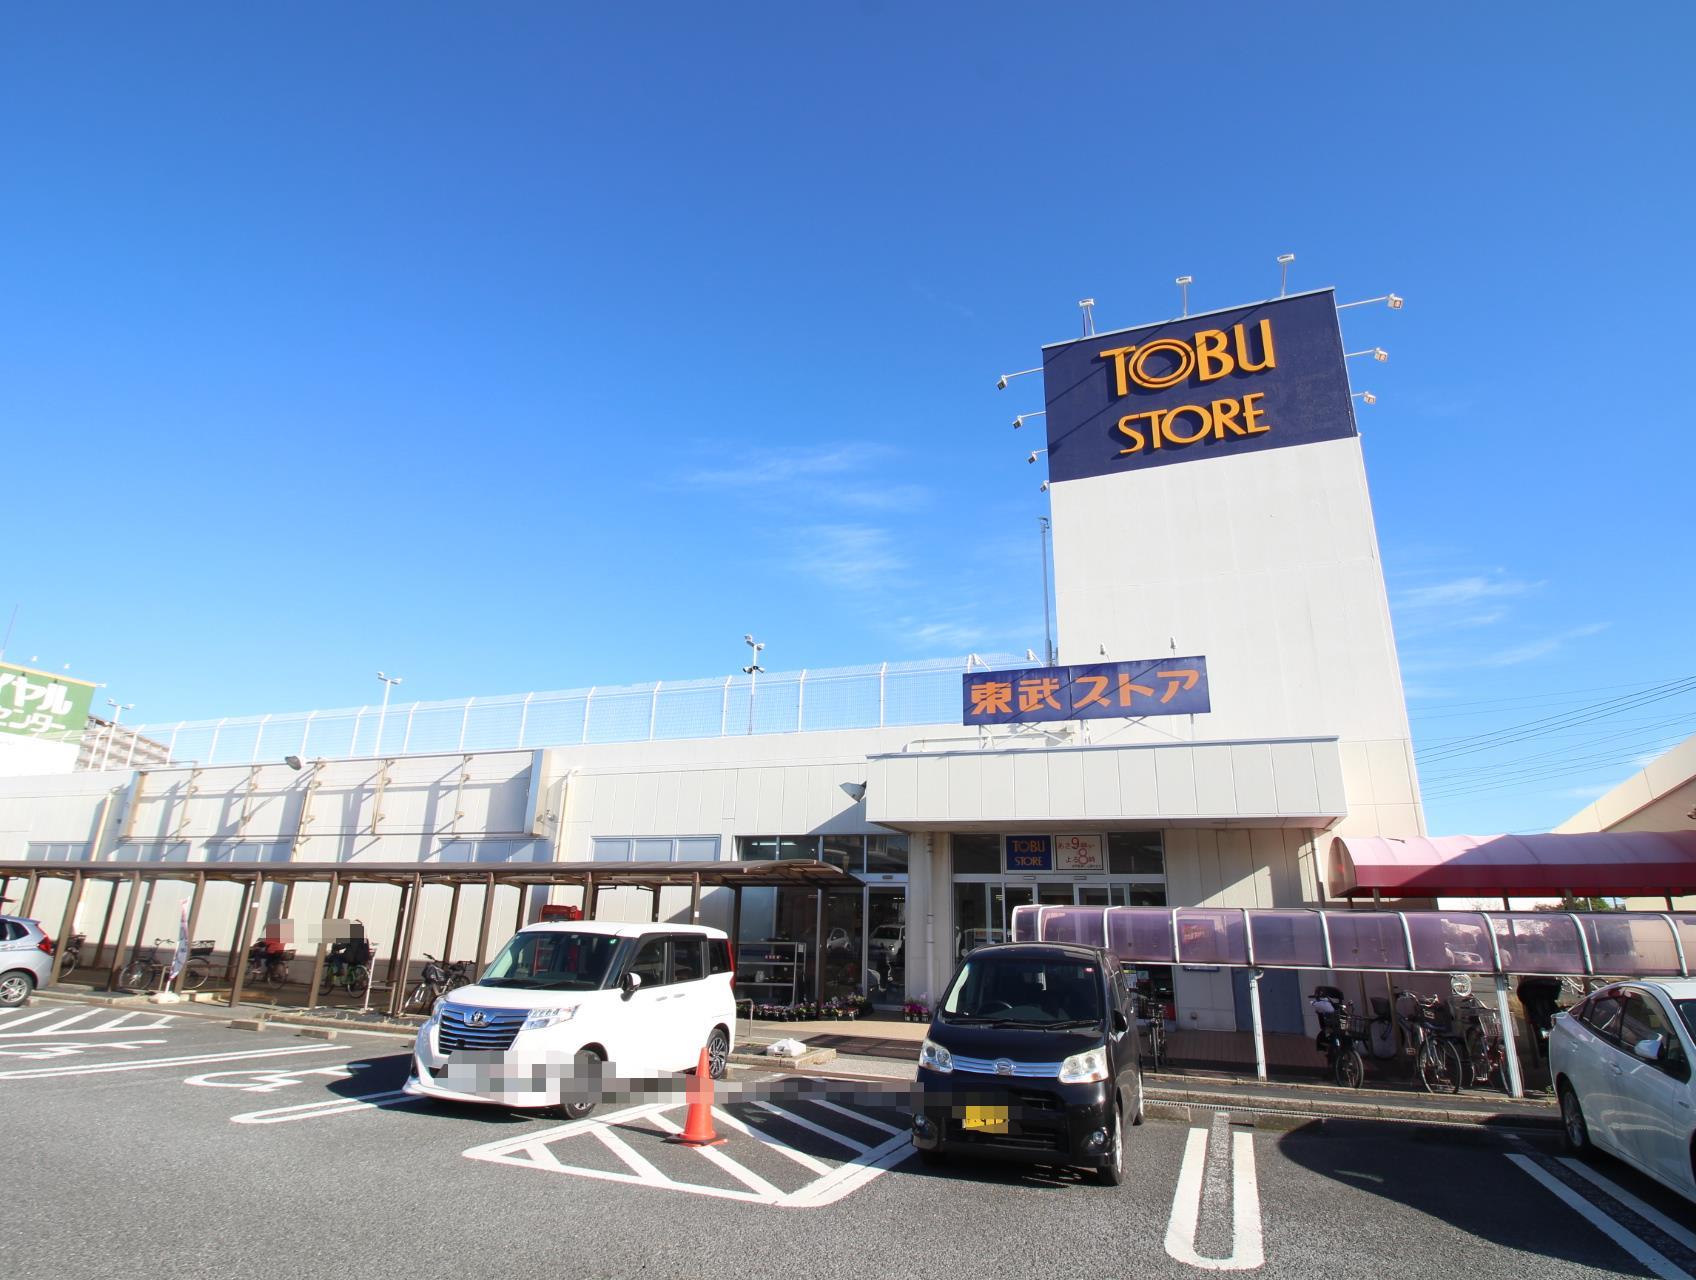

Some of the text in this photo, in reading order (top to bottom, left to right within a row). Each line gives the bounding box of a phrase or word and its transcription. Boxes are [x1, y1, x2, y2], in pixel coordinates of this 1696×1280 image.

[1100, 319, 1276, 397] TOBU
[1118, 392, 1271, 455] STORE
[971, 669, 1200, 716] 東武ストア
[1012, 840, 1046, 852] TOBU
[1014, 856, 1043, 866] STORE
